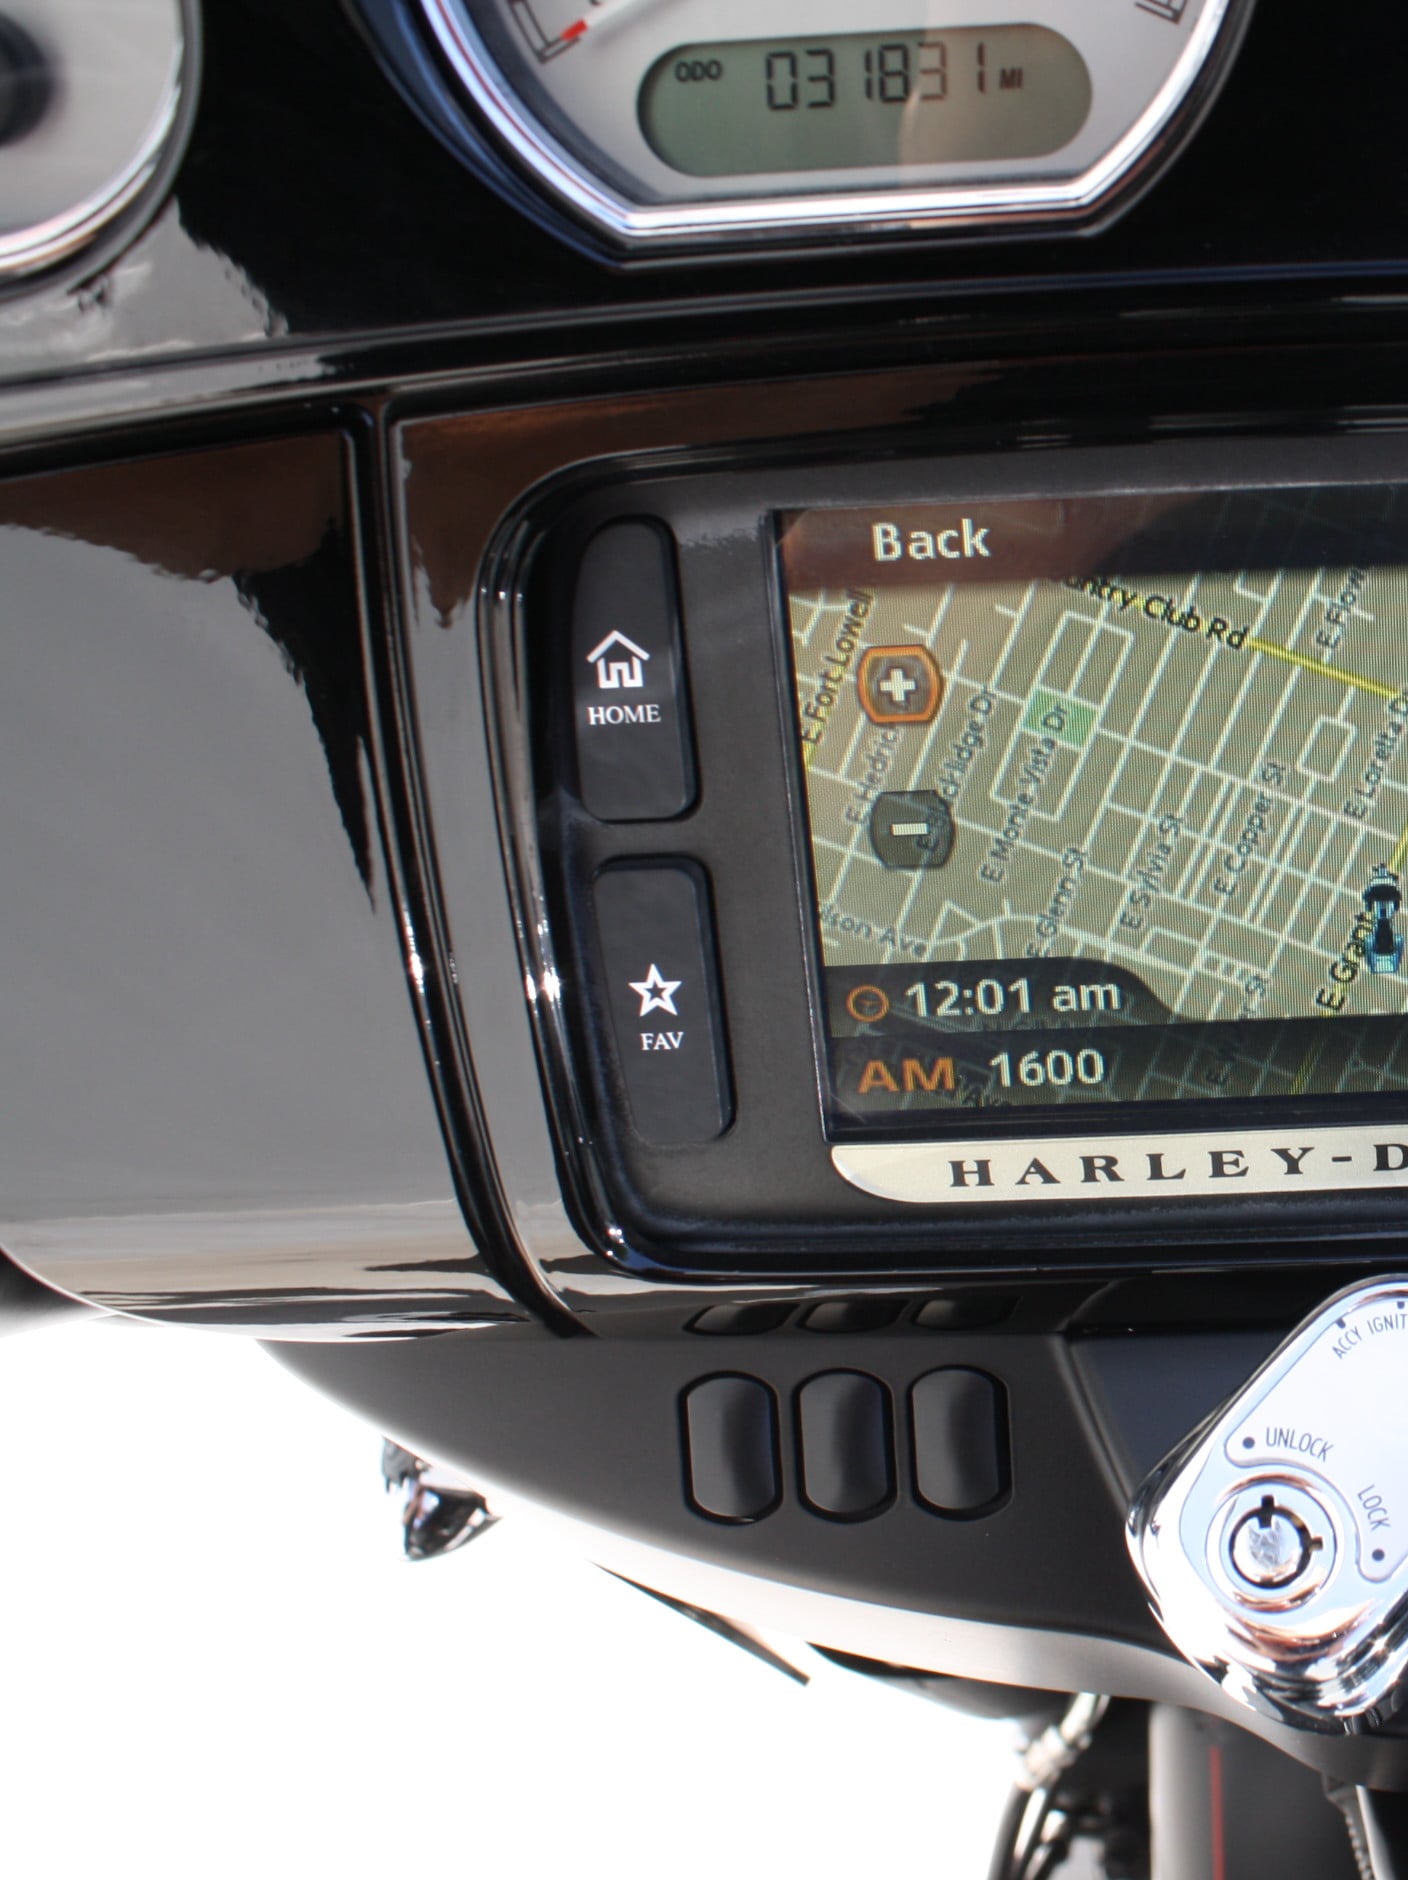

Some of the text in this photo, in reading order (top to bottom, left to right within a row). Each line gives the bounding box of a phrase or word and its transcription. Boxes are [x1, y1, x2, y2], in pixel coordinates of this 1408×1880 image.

[674, 41, 1024, 111] ODO 031831 MI
[872, 517, 992, 562] Back
[1144, 595, 1200, 632] Club
[1205, 616, 1250, 650] Rd
[1315, 629, 1341, 650] E
[587, 703, 662, 726] HOME
[805, 668, 843, 724] Fort
[969, 685, 998, 715] Dr
[800, 730, 823, 745] E
[1353, 720, 1403, 806] Loretta
[980, 703, 1068, 883] E Monte Vista Dr
[1344, 798, 1367, 820] E
[1214, 762, 1286, 896] E Copper St
[1037, 876, 1078, 939] Glenn
[1061, 847, 1087, 871] St
[1120, 911, 1142, 931] E
[1158, 813, 1183, 838] St
[878, 925, 927, 958] Ave
[904, 977, 1122, 1018] 12:01 am
[1315, 987, 1346, 1011] E
[639, 1031, 684, 1051] FAV
[857, 1047, 1105, 1095] AM 1600
[1331, 1325, 1364, 1360] ACCY
[1265, 1426, 1335, 1463] UNLOCK
[1356, 1483, 1392, 1532] LOCK
